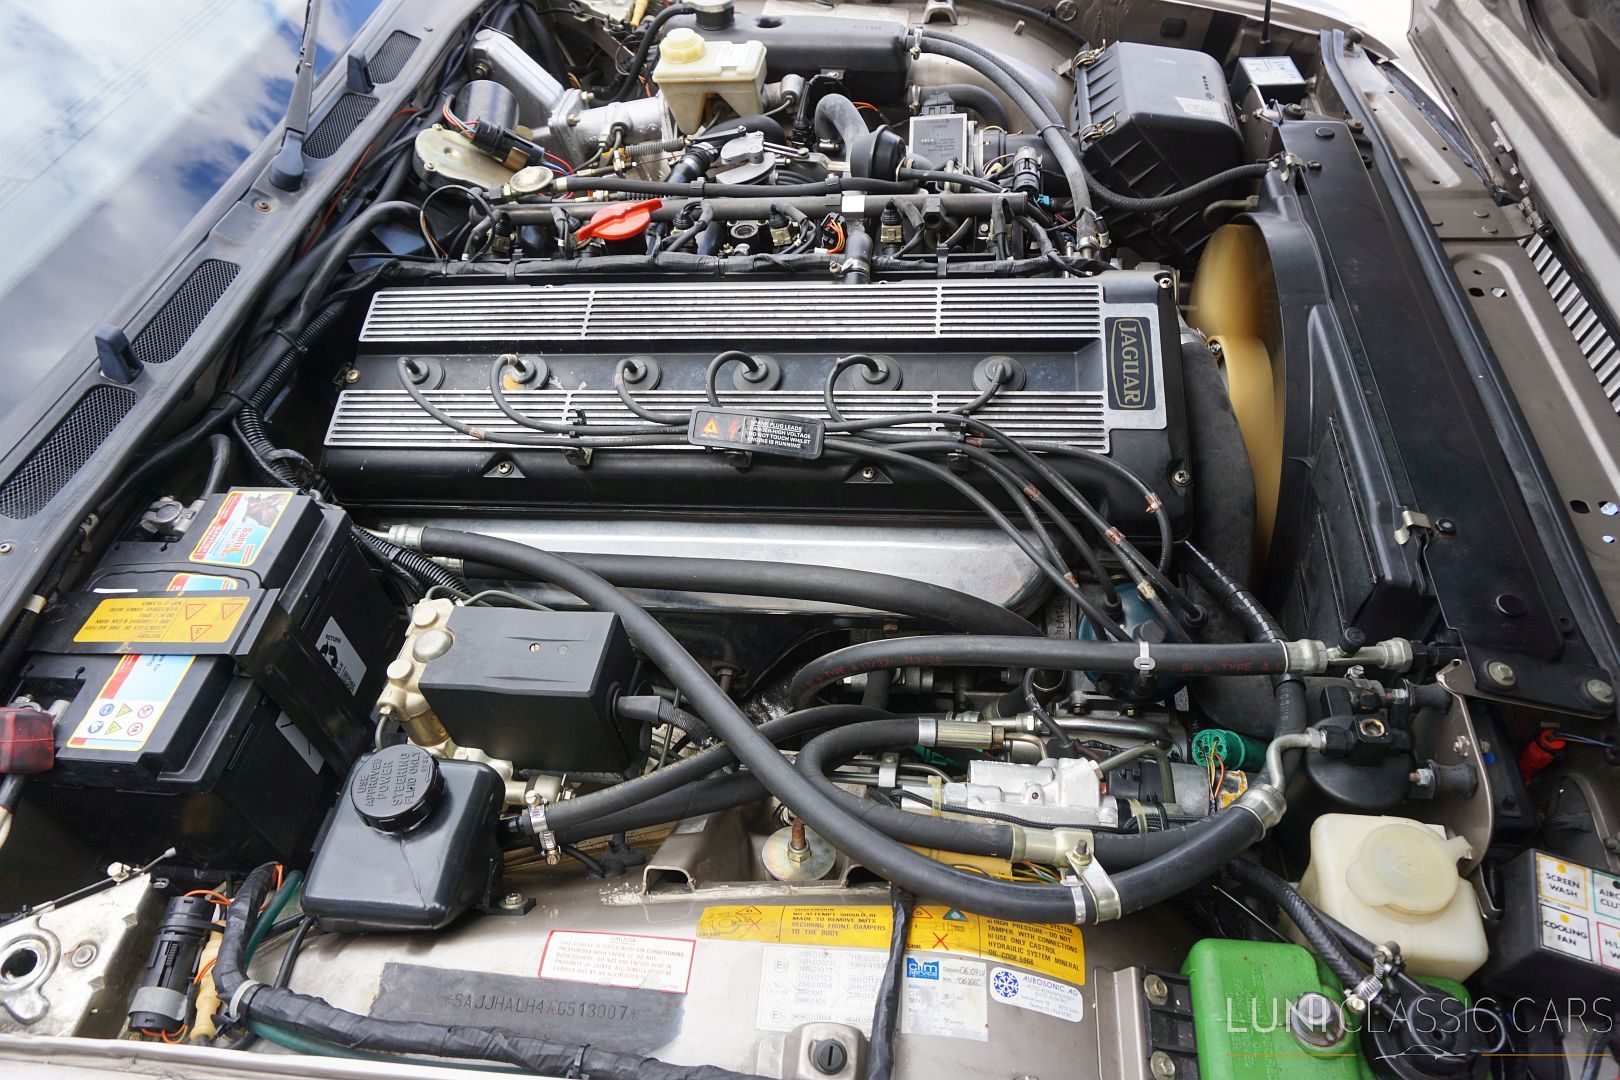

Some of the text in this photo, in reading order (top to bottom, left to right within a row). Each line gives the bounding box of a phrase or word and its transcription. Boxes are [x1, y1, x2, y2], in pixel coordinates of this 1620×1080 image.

[1119, 322, 1140, 404] JAGUAR
[770, 434, 790, 442] TOUCH
[790, 436, 811, 444] WHILST
[774, 440, 801, 448] RUNNING
[786, 430, 811, 439] VOLTAGE
[1221, 662, 1254, 672] TYPE
[357, 774, 370, 794] USE
[364, 758, 382, 806] APPROVED
[376, 760, 394, 800] POWER
[392, 752, 411, 806] STEERING
[403, 751, 421, 804] FLUID ONLY
[1546, 872, 1580, 889] SCREEN
[1550, 883, 1578, 898] WASH
[1544, 920, 1588, 939] COOLING
[988, 925, 1078, 954] TAMPER WITH CONNECTIONS
[995, 934, 1007, 942] USE
[1010, 938, 1026, 946] ONLY
[1030, 941, 1056, 954] CASTROL
[1060, 936, 1072, 944] NOT
[1557, 934, 1577, 946] FAN
[988, 941, 1079, 970] HYDRAULIC SYSTEM MINERAL
[1002, 952, 1018, 960] CODE
[1022, 975, 1078, 997] AUBOSONIC AG
